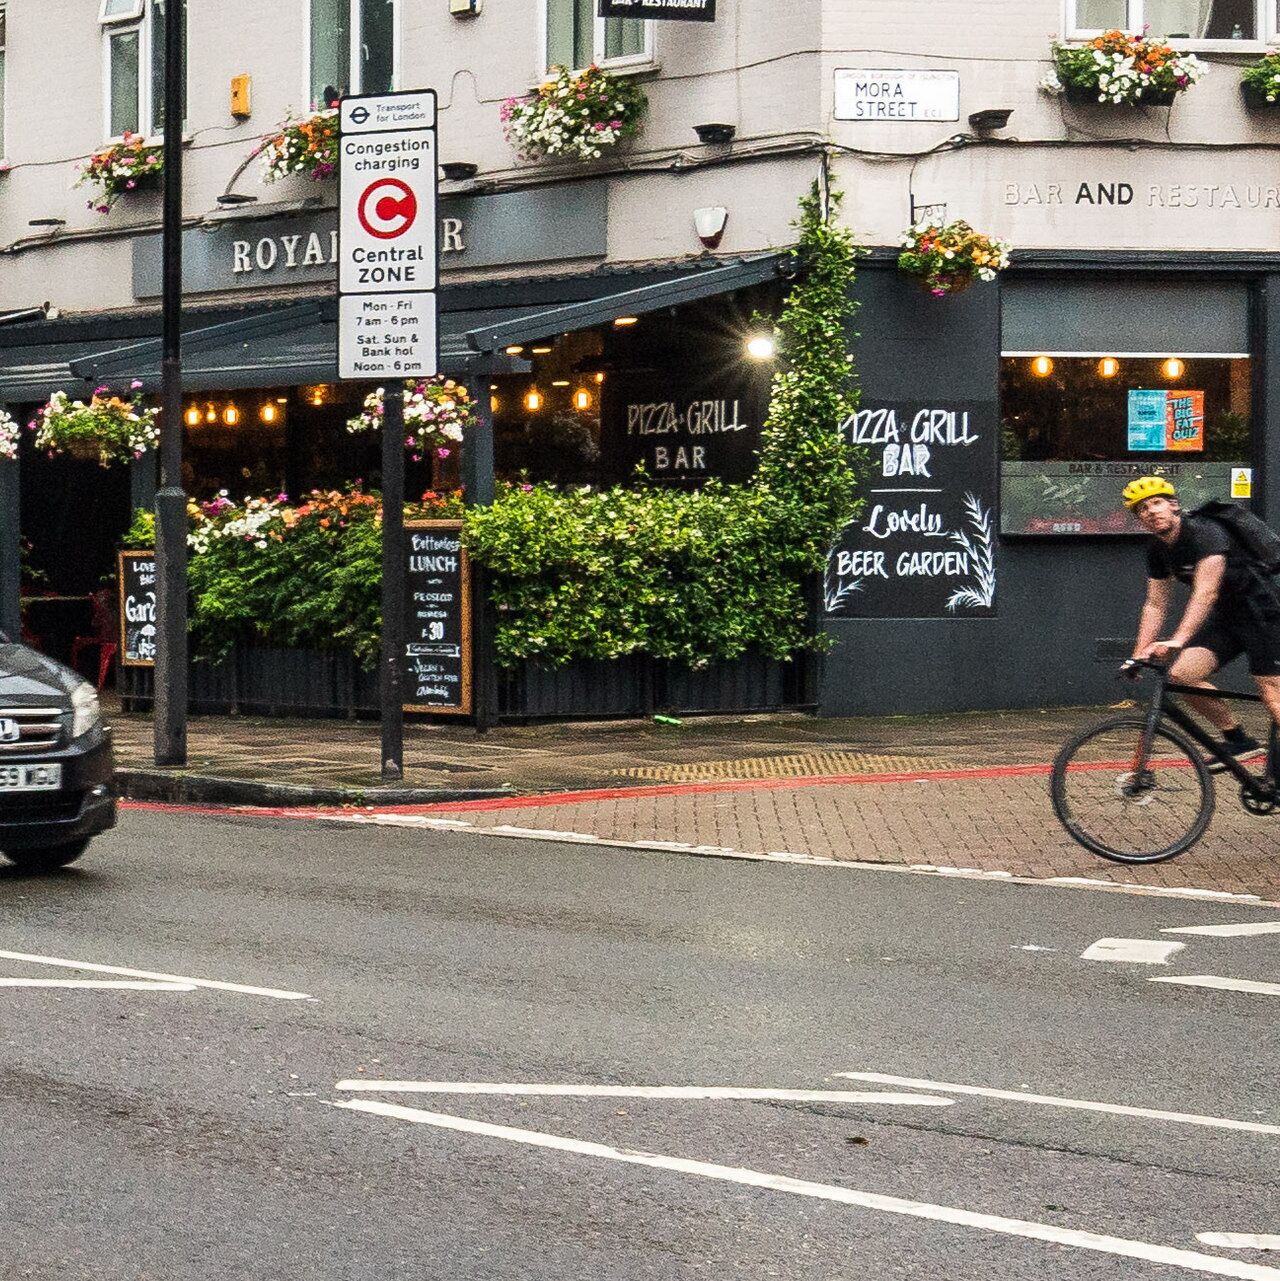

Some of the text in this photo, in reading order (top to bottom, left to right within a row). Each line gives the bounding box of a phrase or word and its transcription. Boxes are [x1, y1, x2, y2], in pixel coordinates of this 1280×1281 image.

[855, 82, 904, 98] MORA
[376, 102, 421, 112] Transport
[856, 100, 918, 117] STREET
[376, 112, 426, 123] for London
[345, 139, 430, 156] Congestion
[354, 157, 420, 172] charging
[1003, 182, 1064, 206] BAR
[1074, 182, 1134, 206] AND
[352, 245, 424, 263] Central
[358, 266, 416, 283] ZONE
[362, 300, 413, 311] Mon Fri
[384, 333, 407, 344] Sun
[409, 333, 419, 343] &
[361, 346, 414, 357] Bank hol
[353, 361, 385, 372] Noon
[626, 400, 749, 435] PIZZA GRILL
[910, 408, 980, 447] GRILL
[654, 446, 706, 469] BAR
[882, 443, 932, 478] BAR
[862, 503, 952, 539] Lovely
[408, 555, 458, 572] LUNCH
[836, 551, 969, 580] BEER GARDEN
